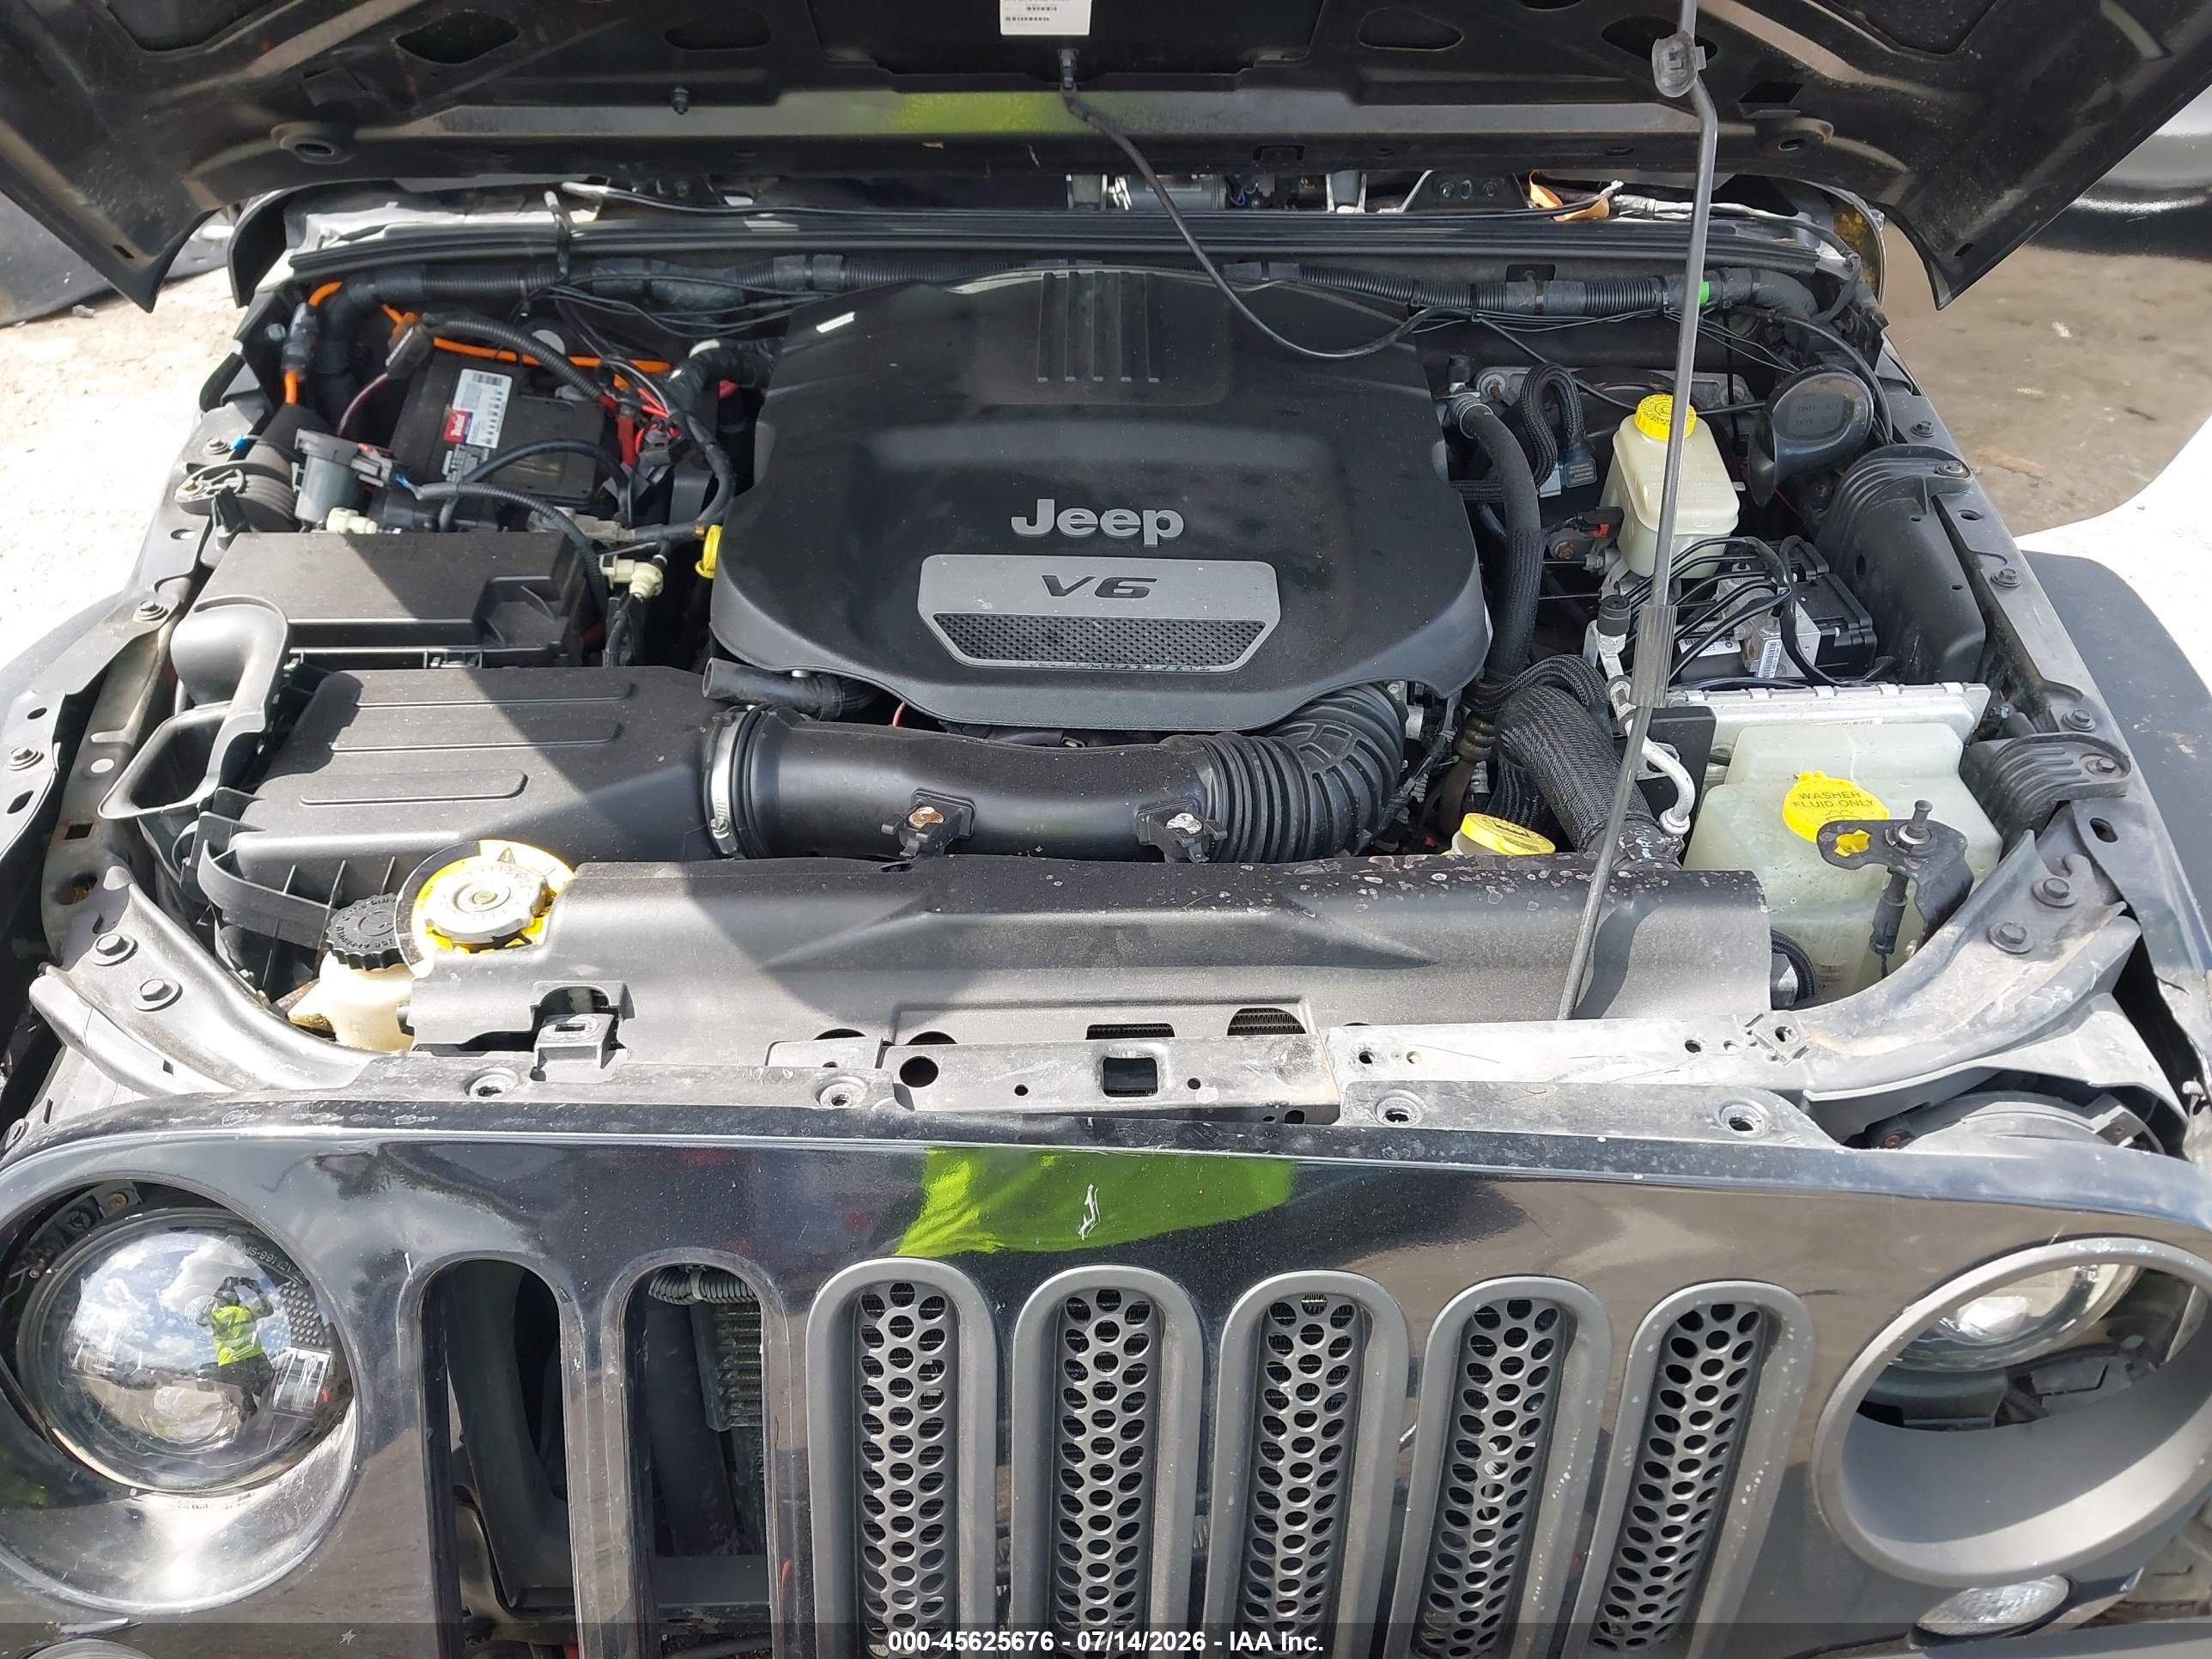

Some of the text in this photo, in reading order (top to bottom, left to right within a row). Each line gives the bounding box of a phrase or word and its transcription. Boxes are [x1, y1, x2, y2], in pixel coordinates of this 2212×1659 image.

[1011, 499, 1184, 548] Jeep
[1042, 574, 1158, 599] V6
[1798, 790, 1862, 799] WASHER
[1792, 799, 1874, 808] FLUID ONLY
